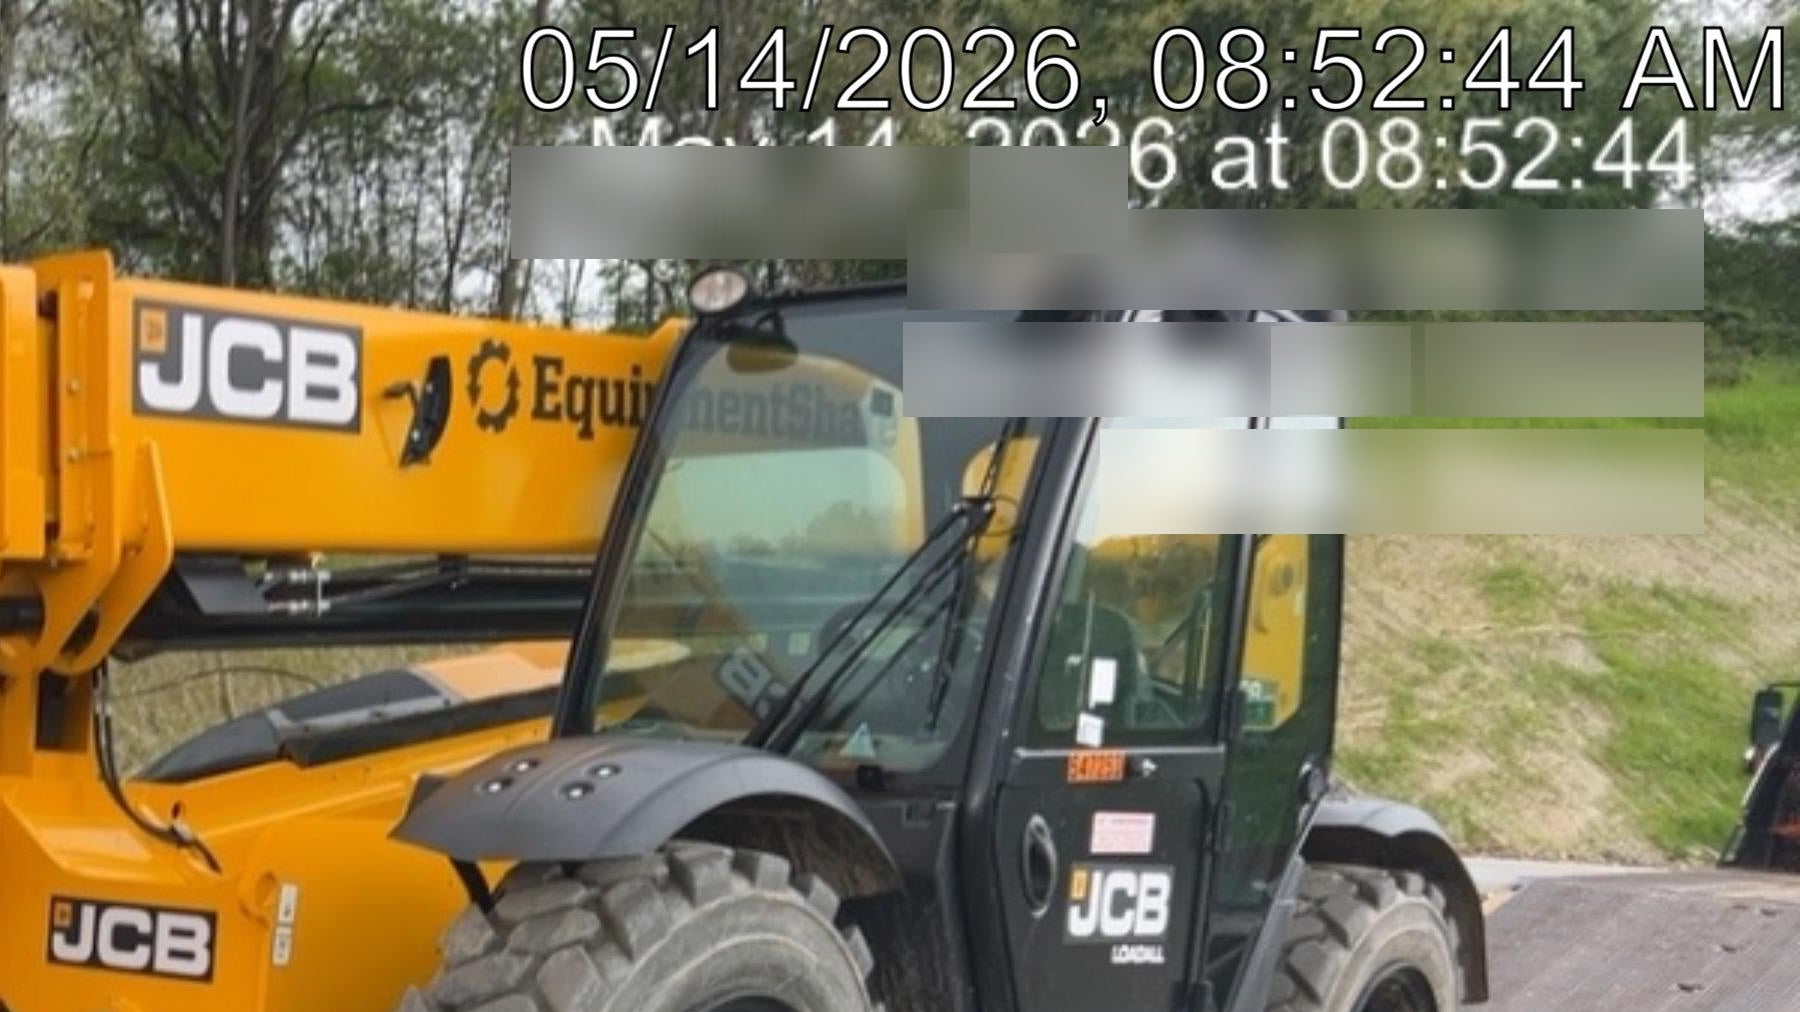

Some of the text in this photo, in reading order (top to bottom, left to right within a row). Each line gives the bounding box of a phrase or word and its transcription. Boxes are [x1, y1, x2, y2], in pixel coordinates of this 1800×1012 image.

[138, 312, 360, 425] JCB
[51, 903, 212, 977] JCB
[1067, 869, 1171, 938] JCB
